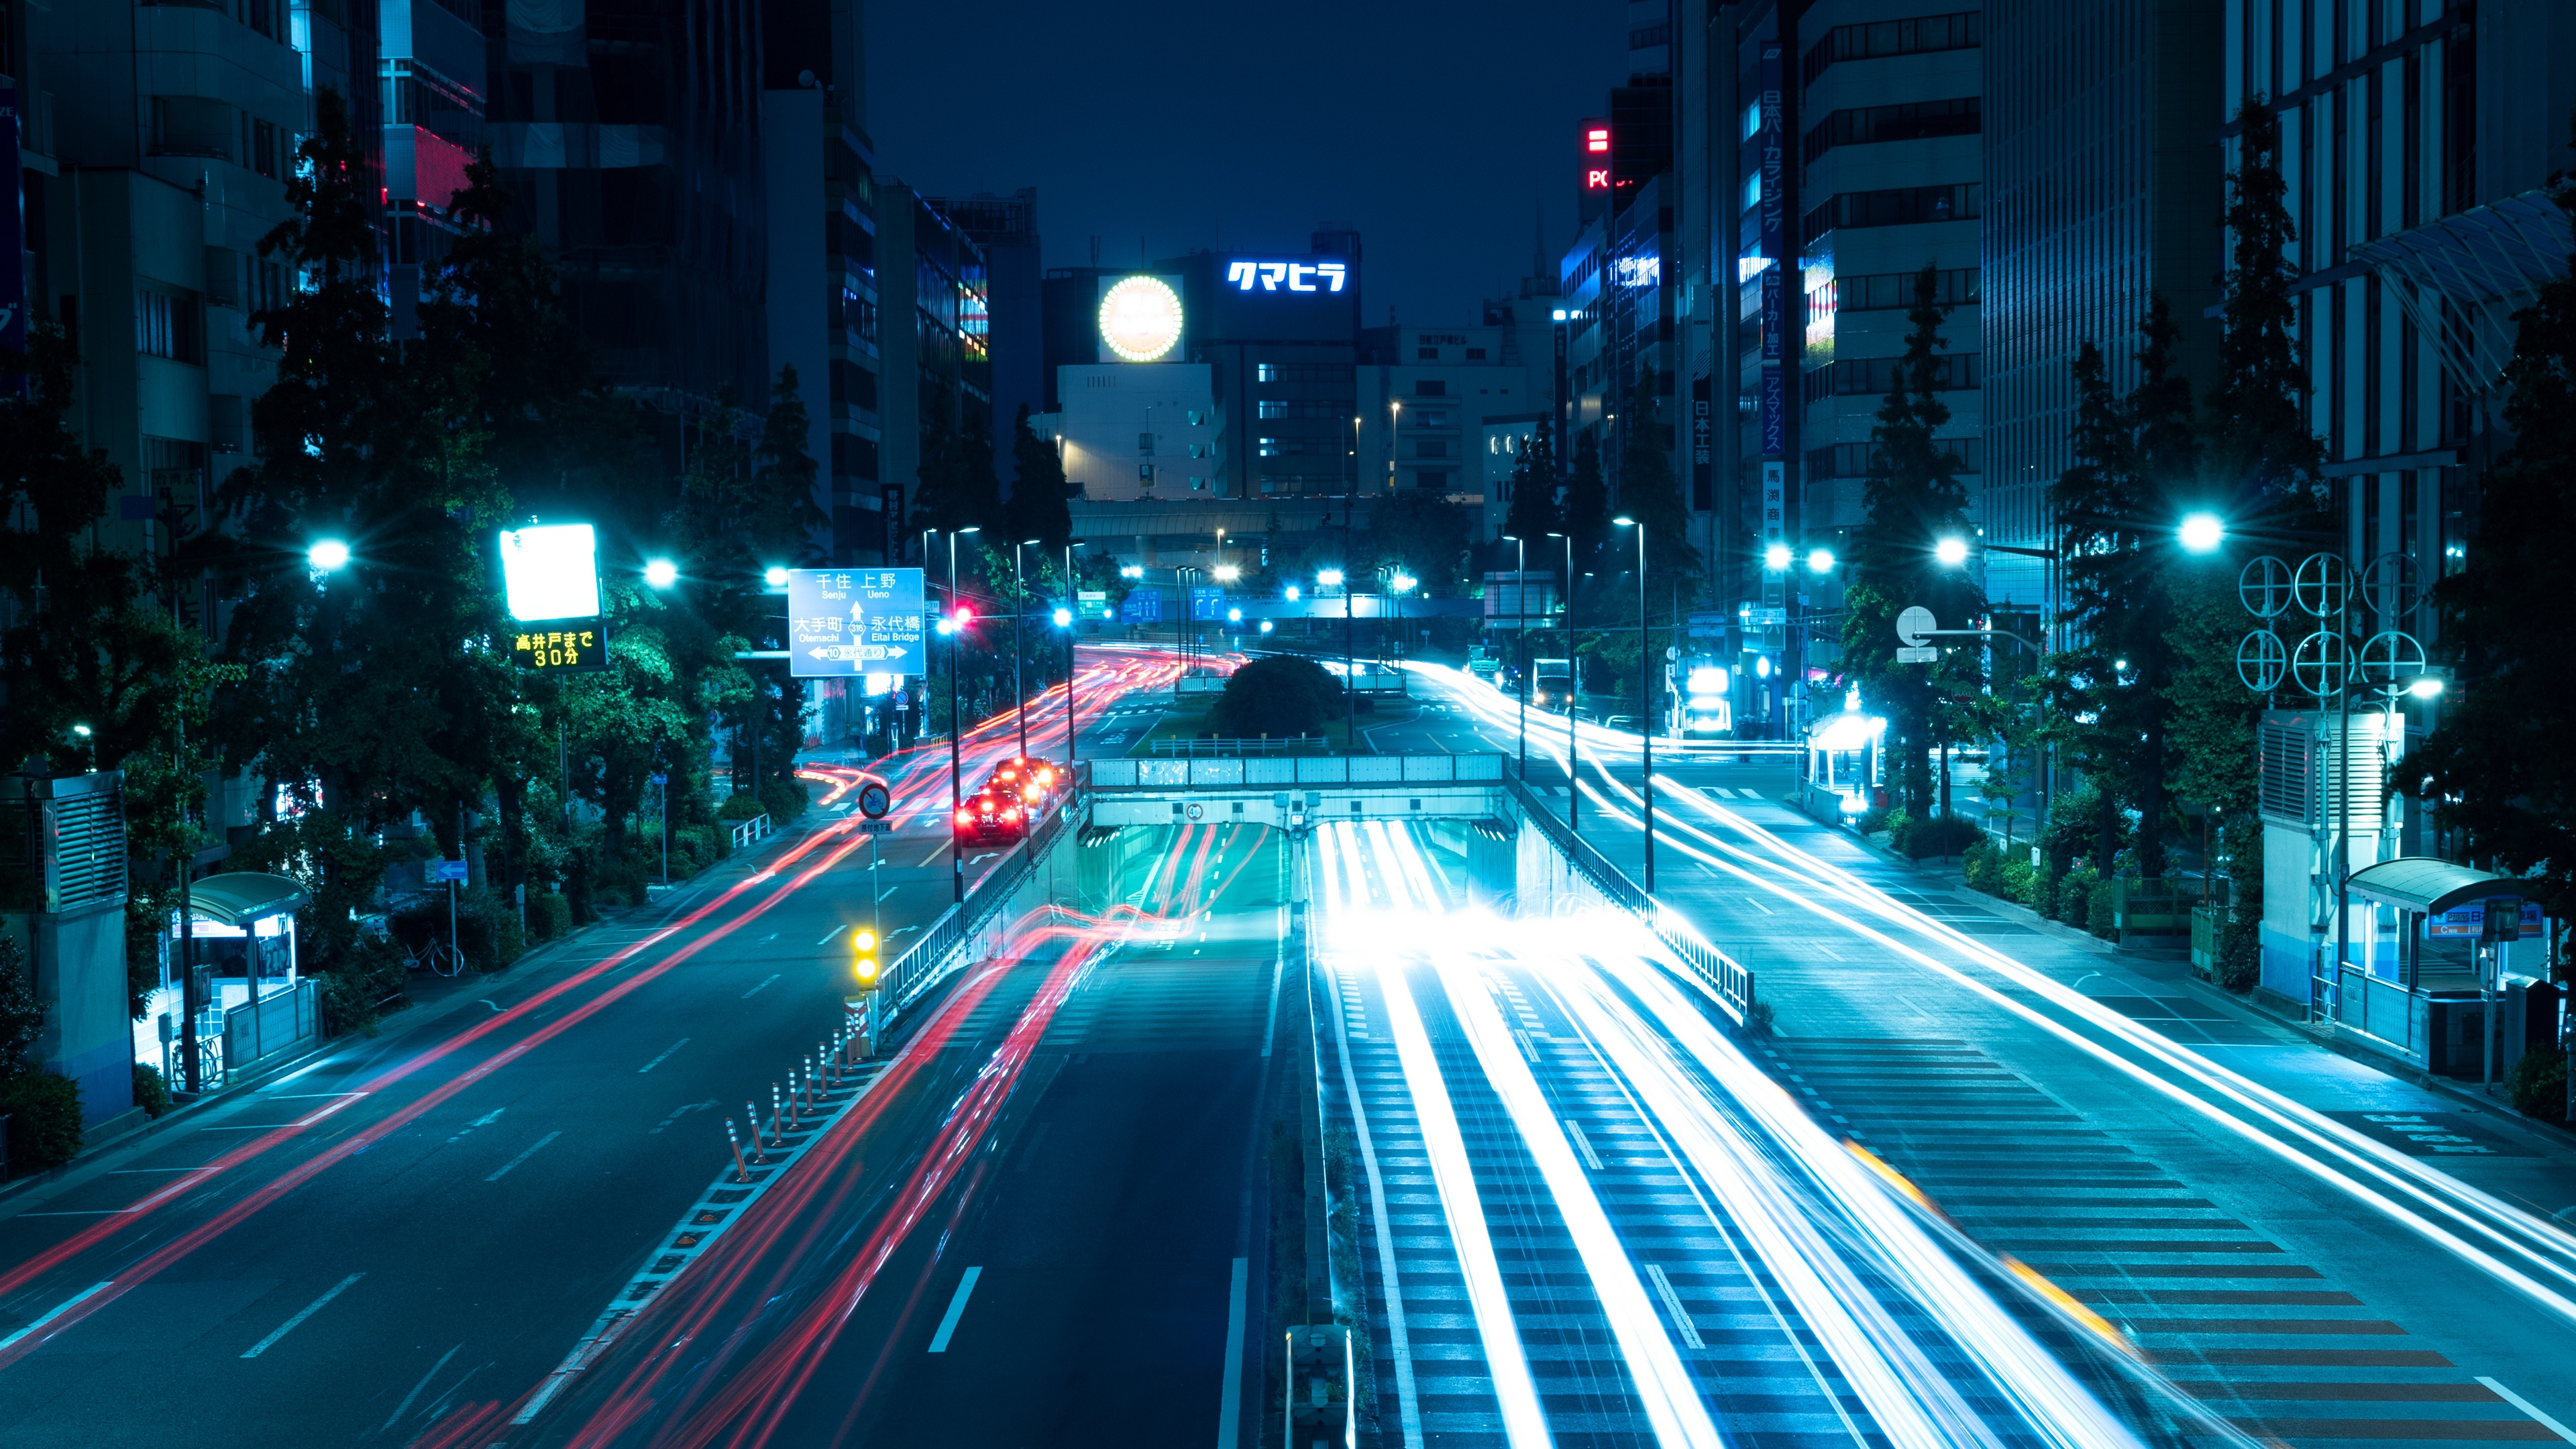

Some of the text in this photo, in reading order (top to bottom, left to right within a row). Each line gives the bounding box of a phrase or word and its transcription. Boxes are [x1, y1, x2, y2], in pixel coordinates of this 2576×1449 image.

[1762, 90, 1782, 233] 日本パーカライジング
[1228, 262, 1346, 292] クマヒラ
[1766, 288, 1779, 356] パーカー加工
[1766, 377, 1781, 450] アズマックス
[1695, 400, 1710, 464] 日本工装
[816, 573, 896, 590] 千住 上野
[822, 590, 890, 600] Senju Ueno
[794, 616, 843, 633] 大手町
[851, 624, 863, 632] 316
[871, 615, 920, 632] 永代橋
[516, 631, 593, 651] 高井戸まで
[798, 633, 839, 643] Otemachi
[872, 632, 920, 643] Eitai Bridge
[535, 647, 578, 667] 30分
[828, 647, 882, 658] 10 永代通り
